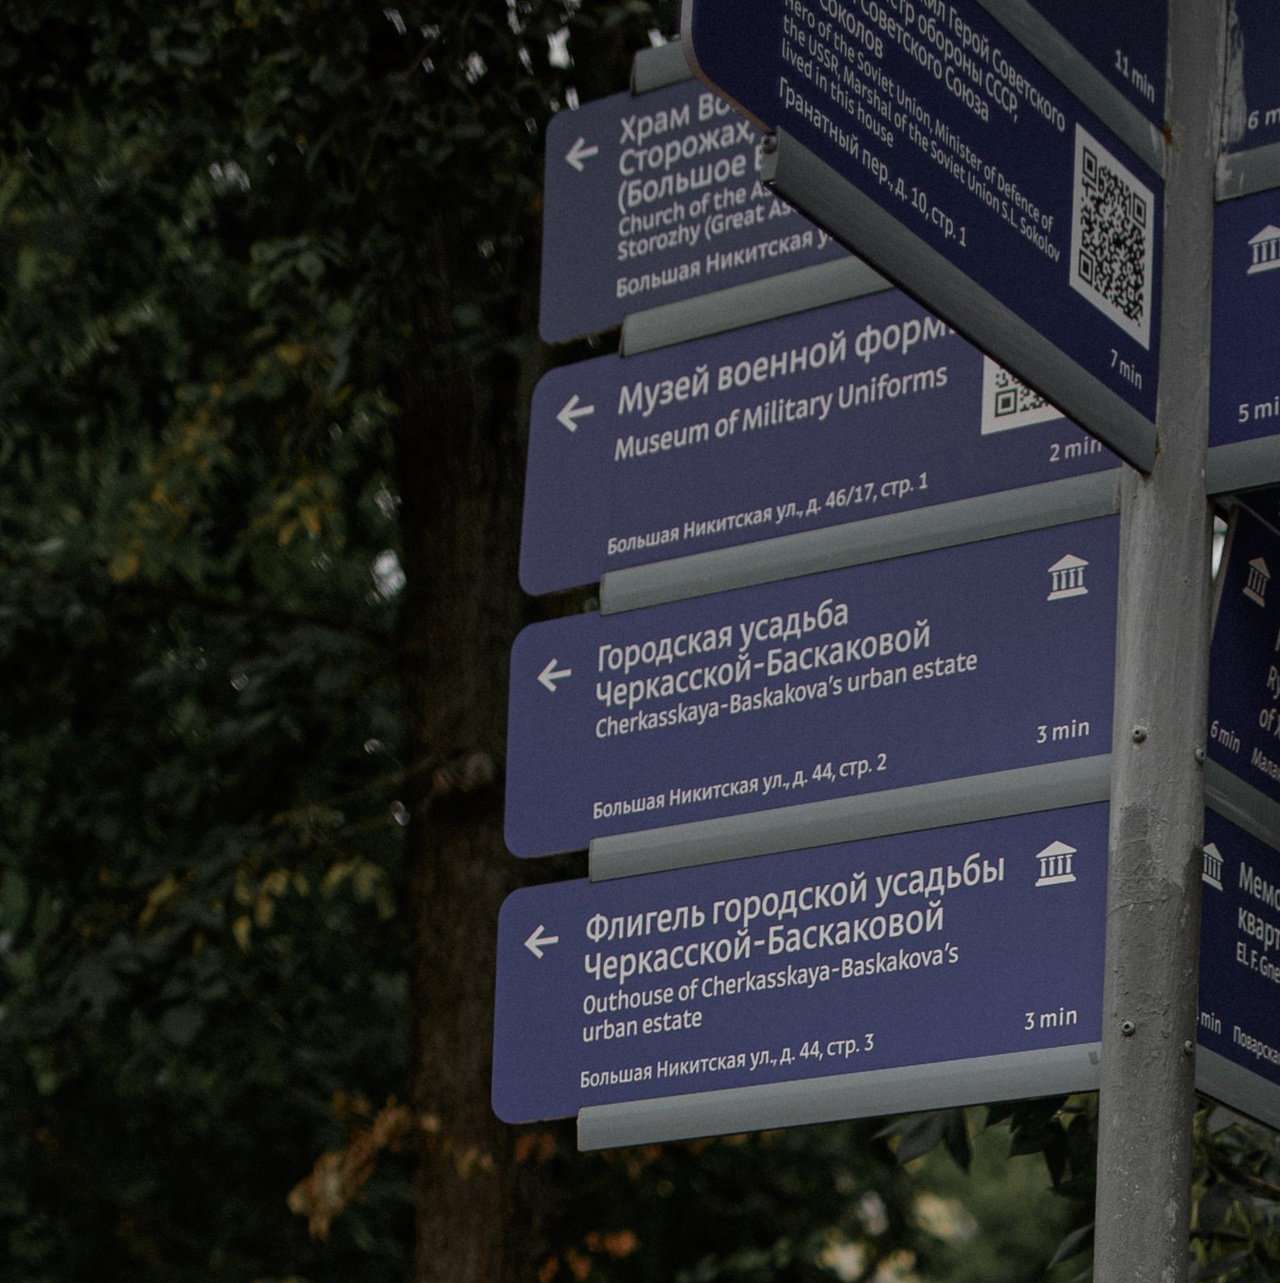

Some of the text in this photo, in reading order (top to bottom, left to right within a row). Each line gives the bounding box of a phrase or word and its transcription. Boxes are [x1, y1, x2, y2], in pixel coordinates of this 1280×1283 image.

[781, 37, 894, 148] lived in this house
[917, 13, 1018, 123] обороны СССР,
[944, 65, 989, 123] Союза
[948, 5, 1066, 133] Герой Советского
[1116, 49, 1155, 104] 11 min
[618, 119, 755, 176] Сторожах,
[619, 103, 690, 147] Храм
[783, 14, 806, 48] the
[808, 34, 841, 82] USSR,
[843, 65, 892, 122] Marshal
[893, 112, 908, 133] of
[908, 121, 929, 153] the
[930, 139, 966, 184] Soviet
[967, 170, 1000, 213] Union
[1019, 216, 1061, 263] Sokolov
[817, 20, 1054, 233] of the Soviet Union, Minister of Defence of
[1247, 109, 1260, 130] 6
[617, 154, 747, 215] (Большое
[779, 76, 859, 160] Гранатный
[862, 148, 894, 192] пер.,
[911, 187, 930, 221] 10,
[931, 206, 956, 240] стр.
[959, 226, 966, 248] 1
[617, 204, 765, 261] Storozhy (Great
[618, 187, 747, 237] Church of the
[616, 230, 813, 298] Большая Никитская
[617, 316, 955, 418] Музей военной форм
[1110, 348, 1142, 390] 7 min
[614, 366, 948, 462] Museum of Military Uniforms
[1238, 403, 1250, 423] 5
[1049, 443, 1060, 463] 2
[607, 471, 928, 555] Большая Никитская ул., д. 46/17, стр. 1
[596, 618, 930, 711] Черкасской-Баскаковой
[598, 598, 848, 675] Городская усадьба
[847, 666, 907, 693] urban
[912, 653, 978, 681] estate
[1036, 719, 1090, 744] 3 min
[1210, 719, 1241, 754] 6 min
[1258, 707, 1277, 732] of
[593, 753, 887, 820] Большая Никитская ул., д. 44, стр. 2
[586, 852, 1004, 943] Флигель городской усадьбы
[584, 899, 944, 986] Черкасской-Баскаковой
[583, 987, 674, 1015] Outhouse
[678, 977, 700, 1002] of
[1024, 1007, 1077, 1031] 3 min
[1200, 1011, 1222, 1035] min
[583, 1009, 703, 1043] urban estate
[580, 1033, 874, 1089] Большая Никитская ул., д. 44, стр. 3
